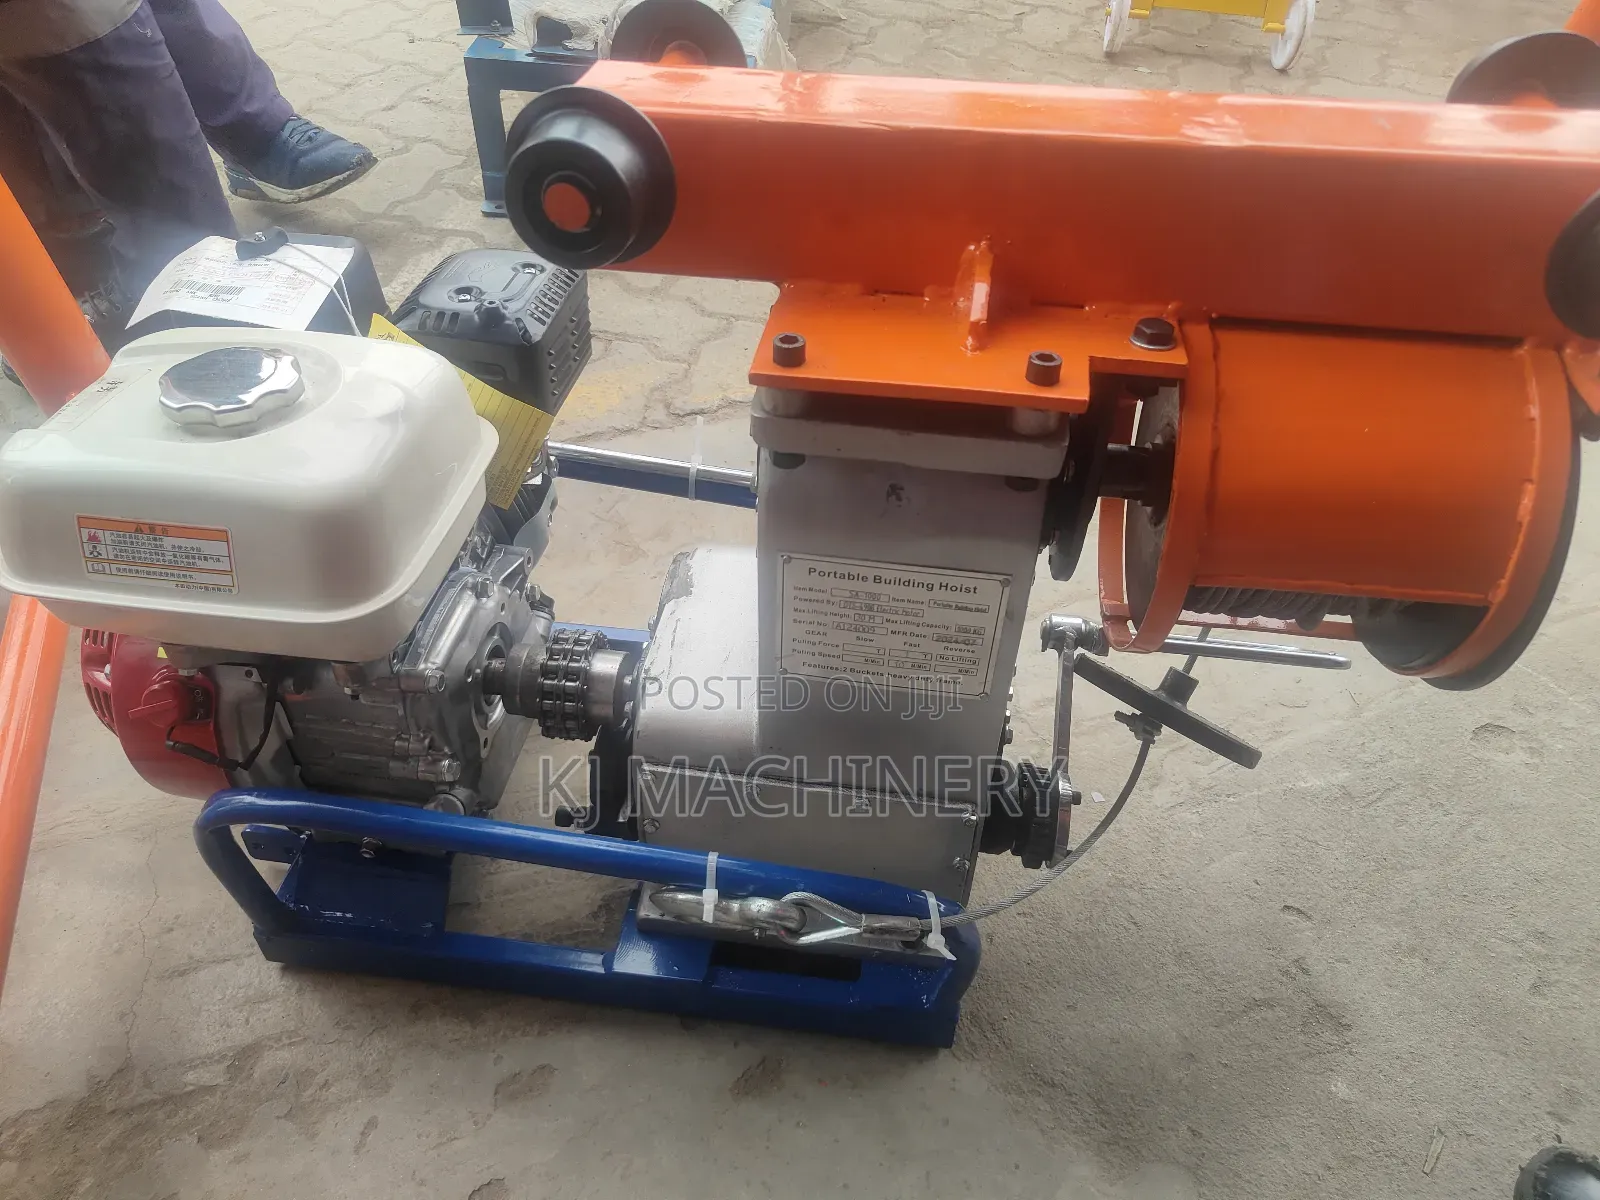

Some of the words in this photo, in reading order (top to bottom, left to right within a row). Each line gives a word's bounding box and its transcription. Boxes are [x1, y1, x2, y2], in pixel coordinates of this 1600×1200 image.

[808, 567, 869, 582] Portable
[873, 575, 935, 592] Building
[939, 582, 978, 594] Hoist
[793, 596, 825, 604] Powered
[892, 596, 906, 604] Item
[792, 618, 815, 626] Serial
[807, 608, 829, 616] Lifting
[900, 620, 921, 628] Lifting
[818, 640, 840, 648] Force
[952, 656, 977, 665] Lifting
[943, 646, 976, 654] Reverse
[818, 652, 841, 660] Speed
